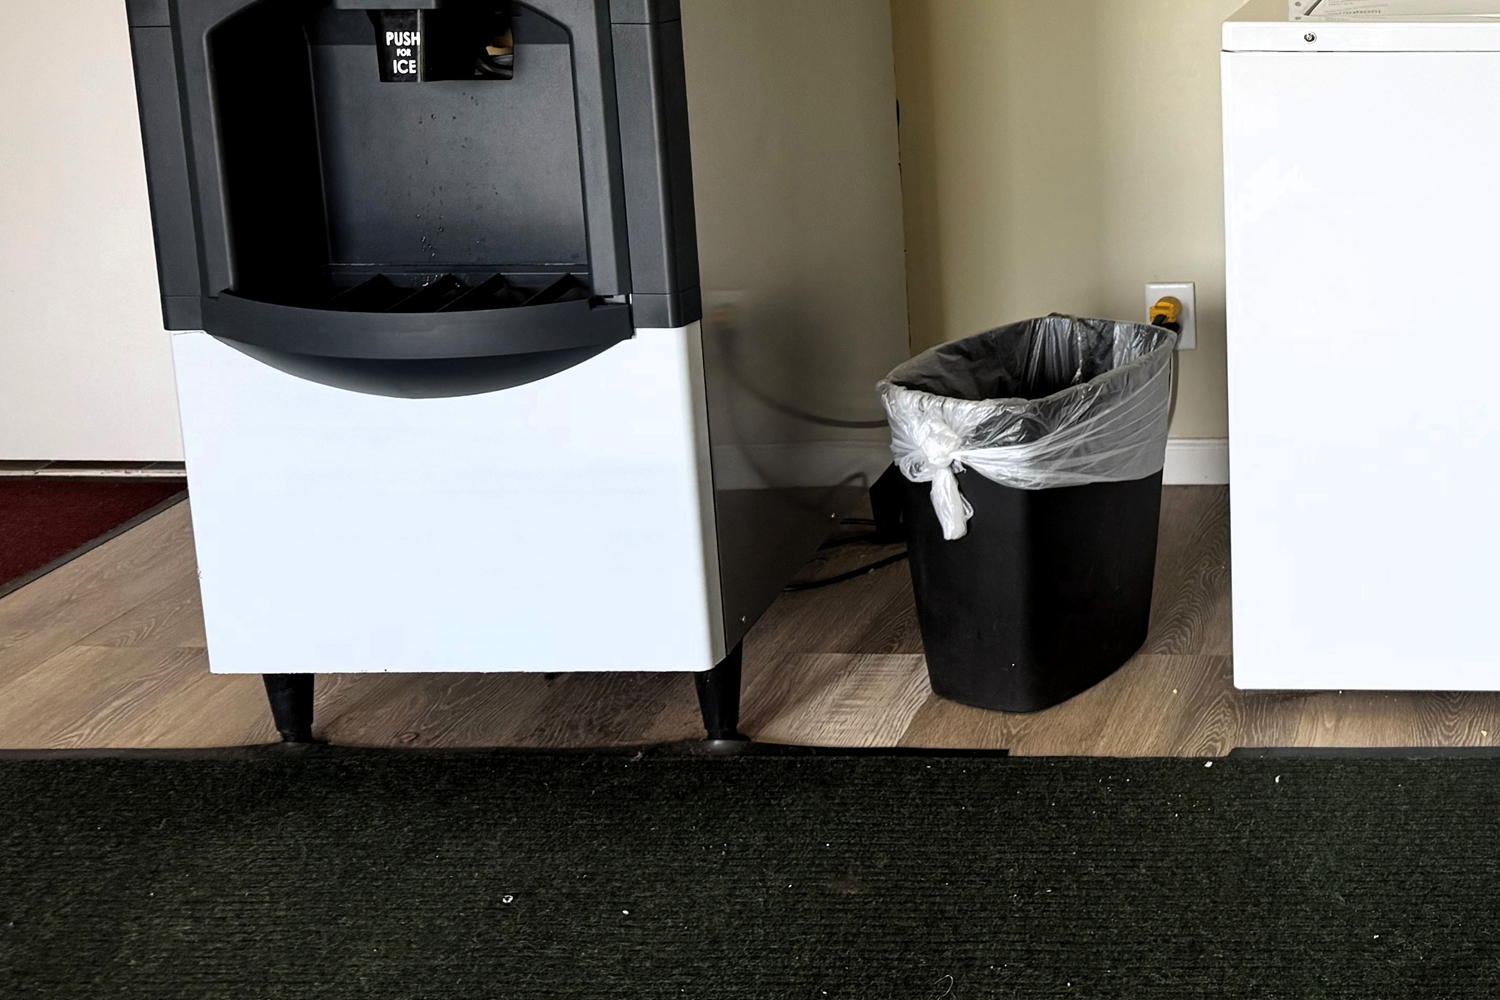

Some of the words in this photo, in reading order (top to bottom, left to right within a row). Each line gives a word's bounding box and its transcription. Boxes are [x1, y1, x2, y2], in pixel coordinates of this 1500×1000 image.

[386, 31, 420, 46] PUSH
[397, 48, 411, 56] FOR
[393, 60, 416, 74] ICE
